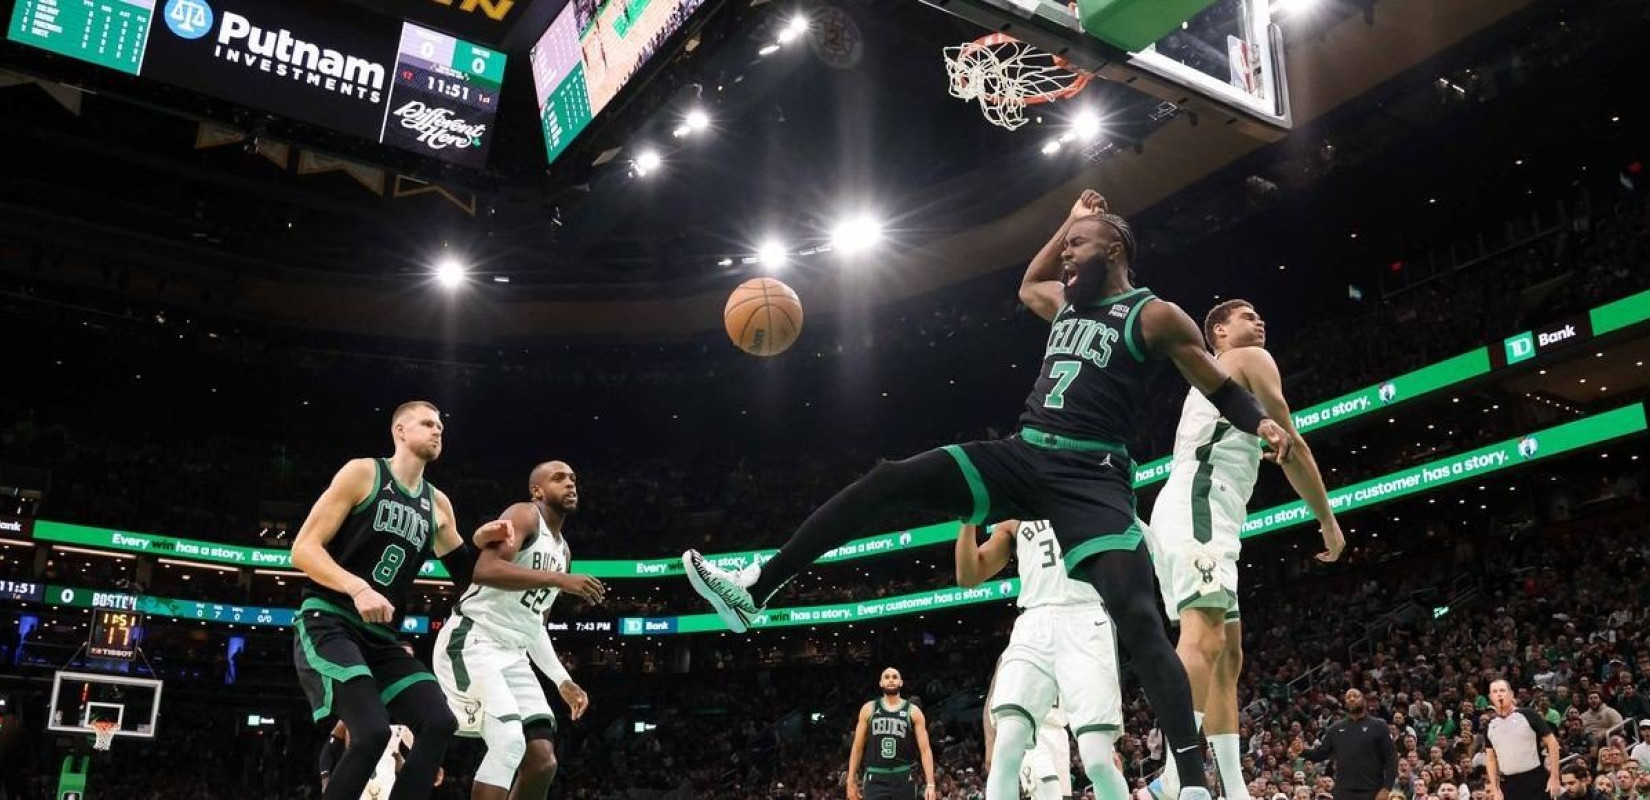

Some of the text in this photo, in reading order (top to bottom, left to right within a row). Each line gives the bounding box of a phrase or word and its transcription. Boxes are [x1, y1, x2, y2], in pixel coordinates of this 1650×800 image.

[218, 11, 385, 90] Putnam
[214, 45, 381, 103] INVESTMENTS
[472, 57, 486, 74] 0
[427, 76, 470, 100] 11:51
[393, 101, 486, 137] Different
[401, 119, 472, 149] Here
[1045, 318, 1119, 369] CELTICS
[1508, 324, 1576, 358] TD Bank
[1044, 361, 1082, 409] 7
[1295, 396, 1371, 429] has a story.
[1135, 468, 1155, 482] has
[1156, 466, 1164, 474] a
[1264, 516, 1272, 525] a
[1274, 506, 1310, 523] story.
[1328, 493, 1352, 507] ery
[1354, 474, 1421, 501] customer
[1423, 465, 1450, 483] has
[1452, 463, 1463, 474] a
[1465, 449, 1509, 471] story.
[0, 521, 21, 532] ank
[373, 499, 429, 552] CELTICS
[111, 533, 149, 549] Every
[152, 540, 174, 550] win
[176, 541, 199, 555] has
[200, 547, 210, 556] a
[210, 546, 246, 561] story.
[252, 551, 286, 564] Every
[858, 544, 866, 552] a
[866, 539, 893, 552] story.
[372, 544, 406, 586] 8
[636, 563, 667, 574] Every
[0, 581, 36, 594] 11:51
[61, 588, 75, 604] 0
[520, 587, 551, 615] 22
[770, 611, 789, 621] win
[790, 610, 811, 621] has
[821, 609, 852, 620] story.
[857, 603, 884, 616] Every
[886, 595, 933, 611] customer
[934, 592, 954, 604] has
[954, 593, 962, 601] a
[963, 587, 993, 599] story.
[548, 622, 611, 631] Bank 7:43 PM
[646, 621, 668, 631] Bank
[872, 717, 907, 739] CELTICS
[881, 737, 896, 758] 9
